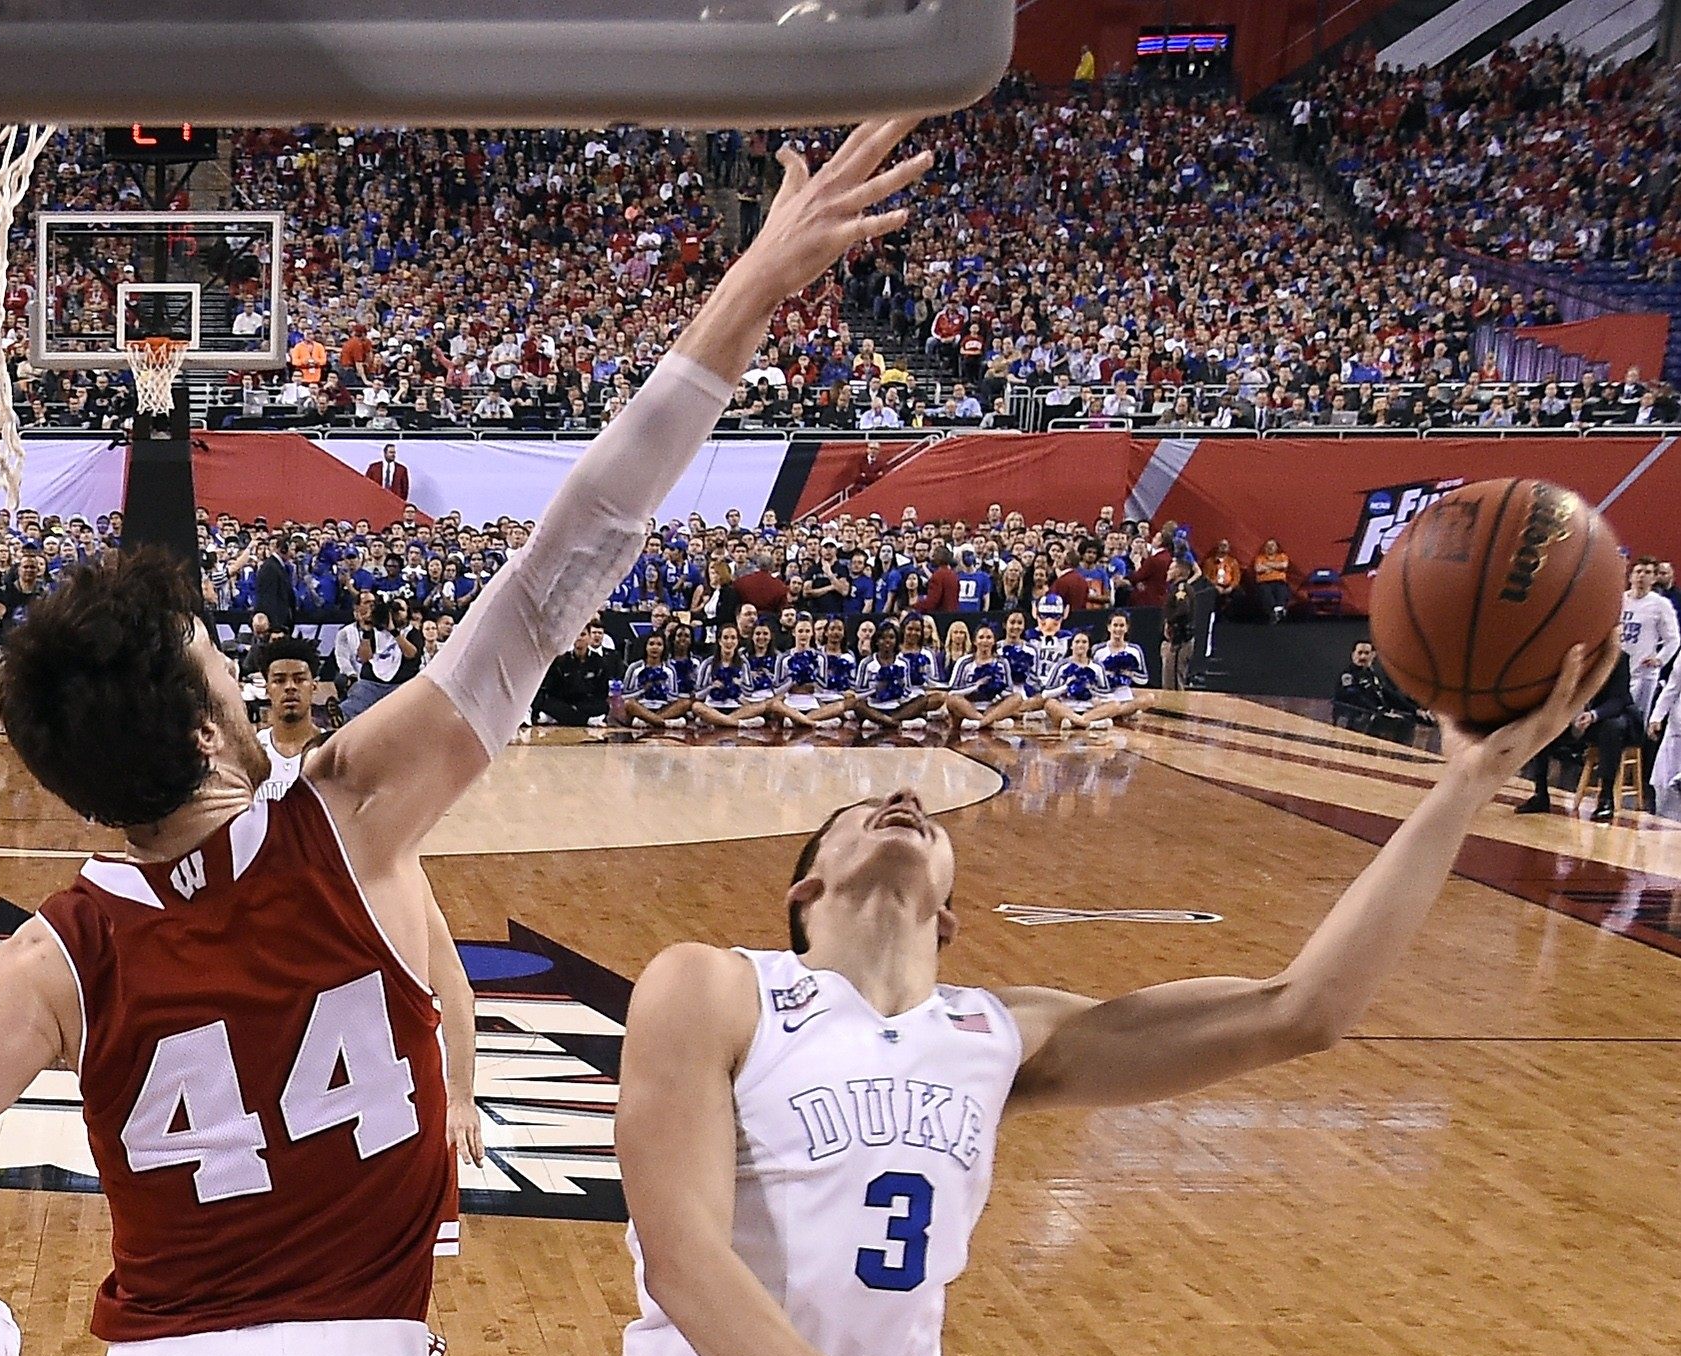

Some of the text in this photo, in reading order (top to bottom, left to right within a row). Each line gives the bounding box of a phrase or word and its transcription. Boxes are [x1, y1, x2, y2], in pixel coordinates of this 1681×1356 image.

[170, 849, 206, 900] W
[120, 970, 420, 1204] 44
[789, 1078, 983, 1171] DUKE
[855, 1171, 935, 1292] 3
